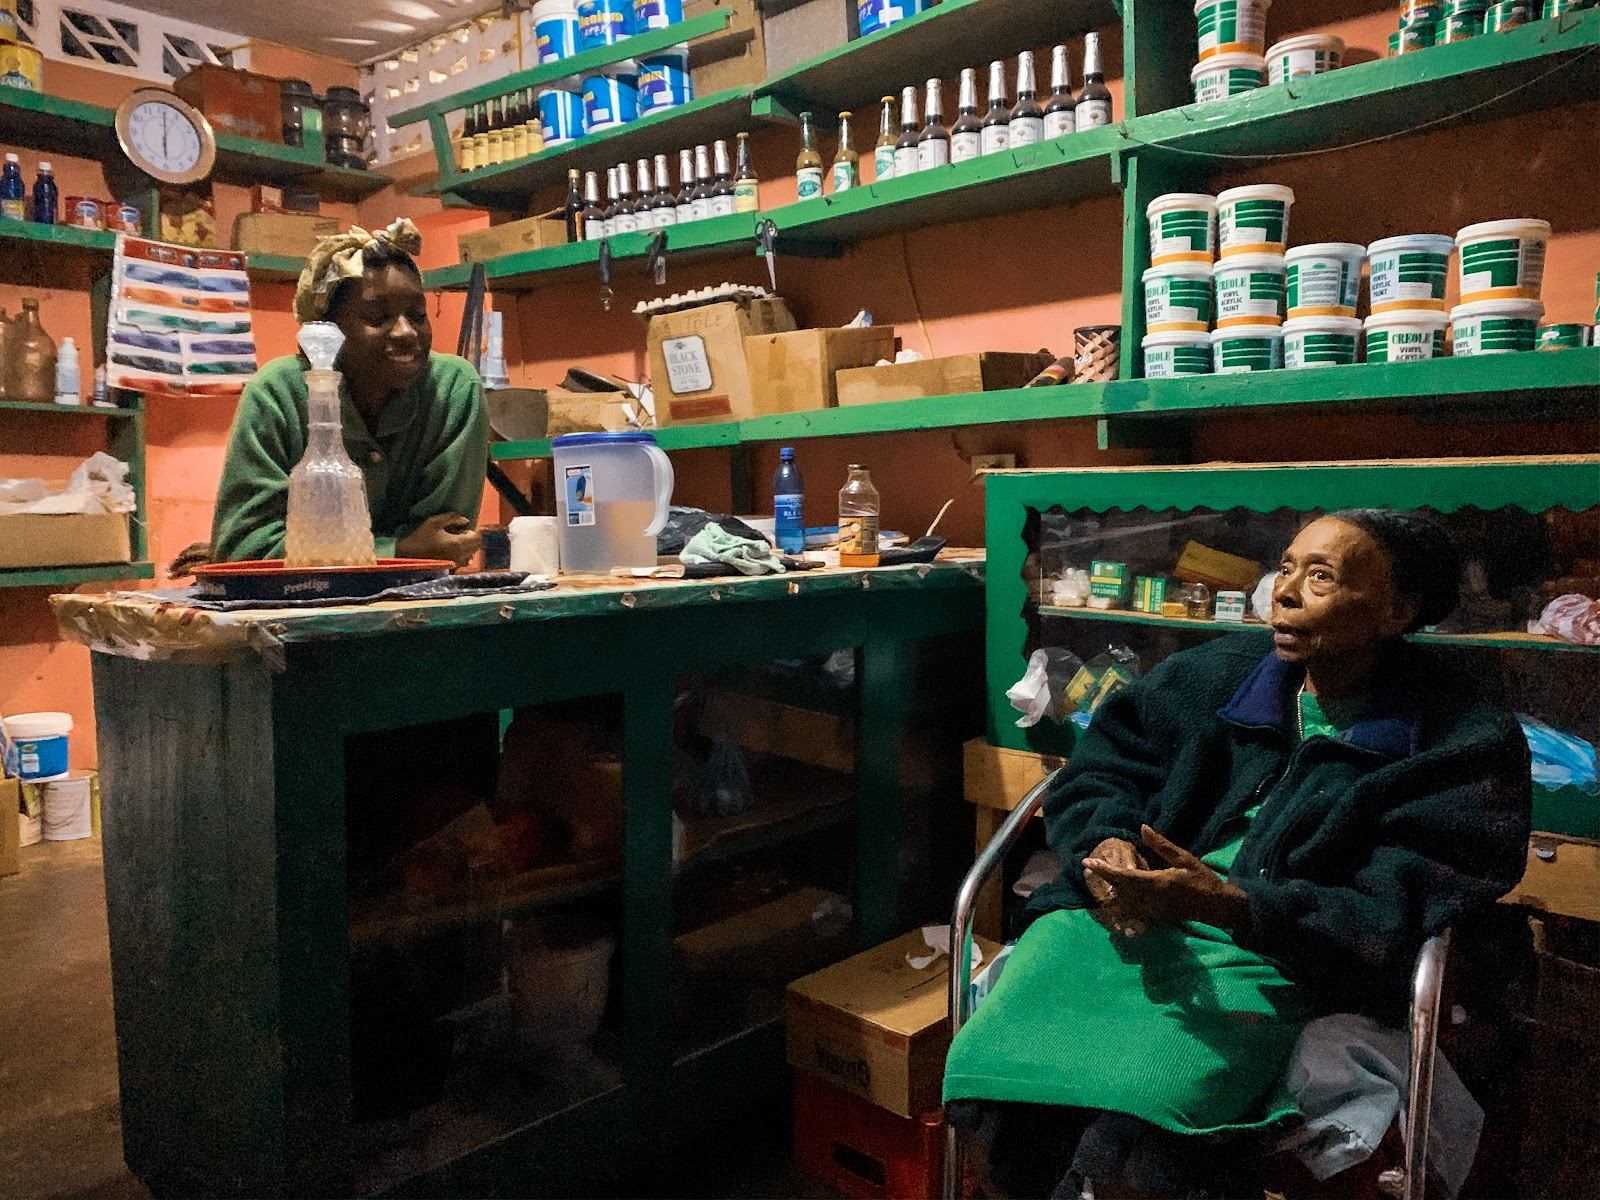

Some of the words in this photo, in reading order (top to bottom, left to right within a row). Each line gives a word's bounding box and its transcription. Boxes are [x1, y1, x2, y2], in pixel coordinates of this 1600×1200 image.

[1392, 333, 1430, 344] CREOLE
[669, 351, 698, 364] BLACK
[671, 362, 702, 376] STONE
[283, 579, 330, 595] Prestige
